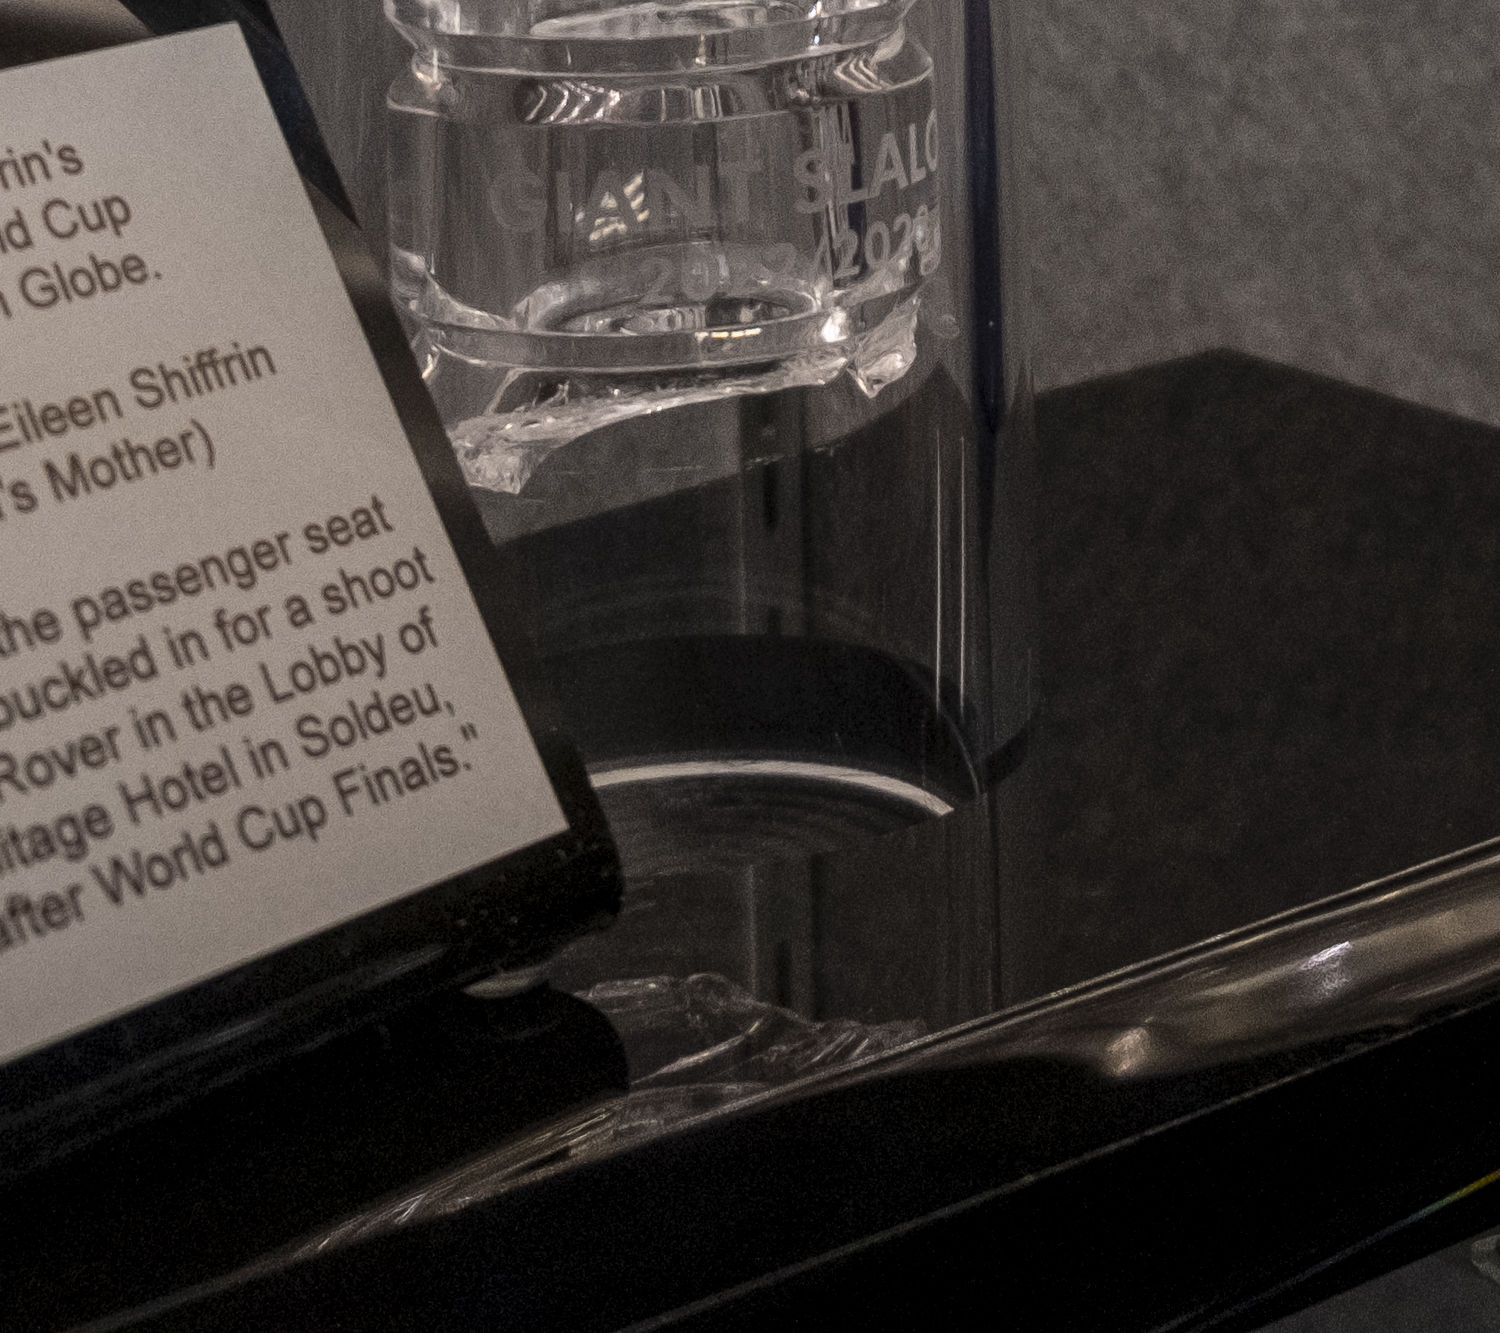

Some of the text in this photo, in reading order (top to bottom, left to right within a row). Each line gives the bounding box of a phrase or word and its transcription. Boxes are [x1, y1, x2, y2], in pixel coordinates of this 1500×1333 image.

[39, 192, 133, 242] Cup
[488, 161, 765, 235] GIANT
[16, 251, 162, 311] Globe.
[126, 340, 278, 412] Shiffrin
[40, 417, 217, 503] Mother)
[68, 529, 293, 643] passenger
[300, 493, 395, 557] seat
[161, 625, 211, 670] in
[211, 603, 273, 653] for
[282, 592, 316, 631] a
[318, 544, 437, 618] shoot
[128, 706, 178, 751] in
[178, 680, 256, 734] the
[256, 632, 388, 706] Lobby
[395, 602, 439, 657] of
[115, 743, 243, 826] Hotel
[241, 736, 292, 781] in
[292, 681, 456, 761] Soldeu,
[88, 819, 232, 908] World
[233, 792, 329, 854] Cup
[329, 721, 479, 818] Finals."
